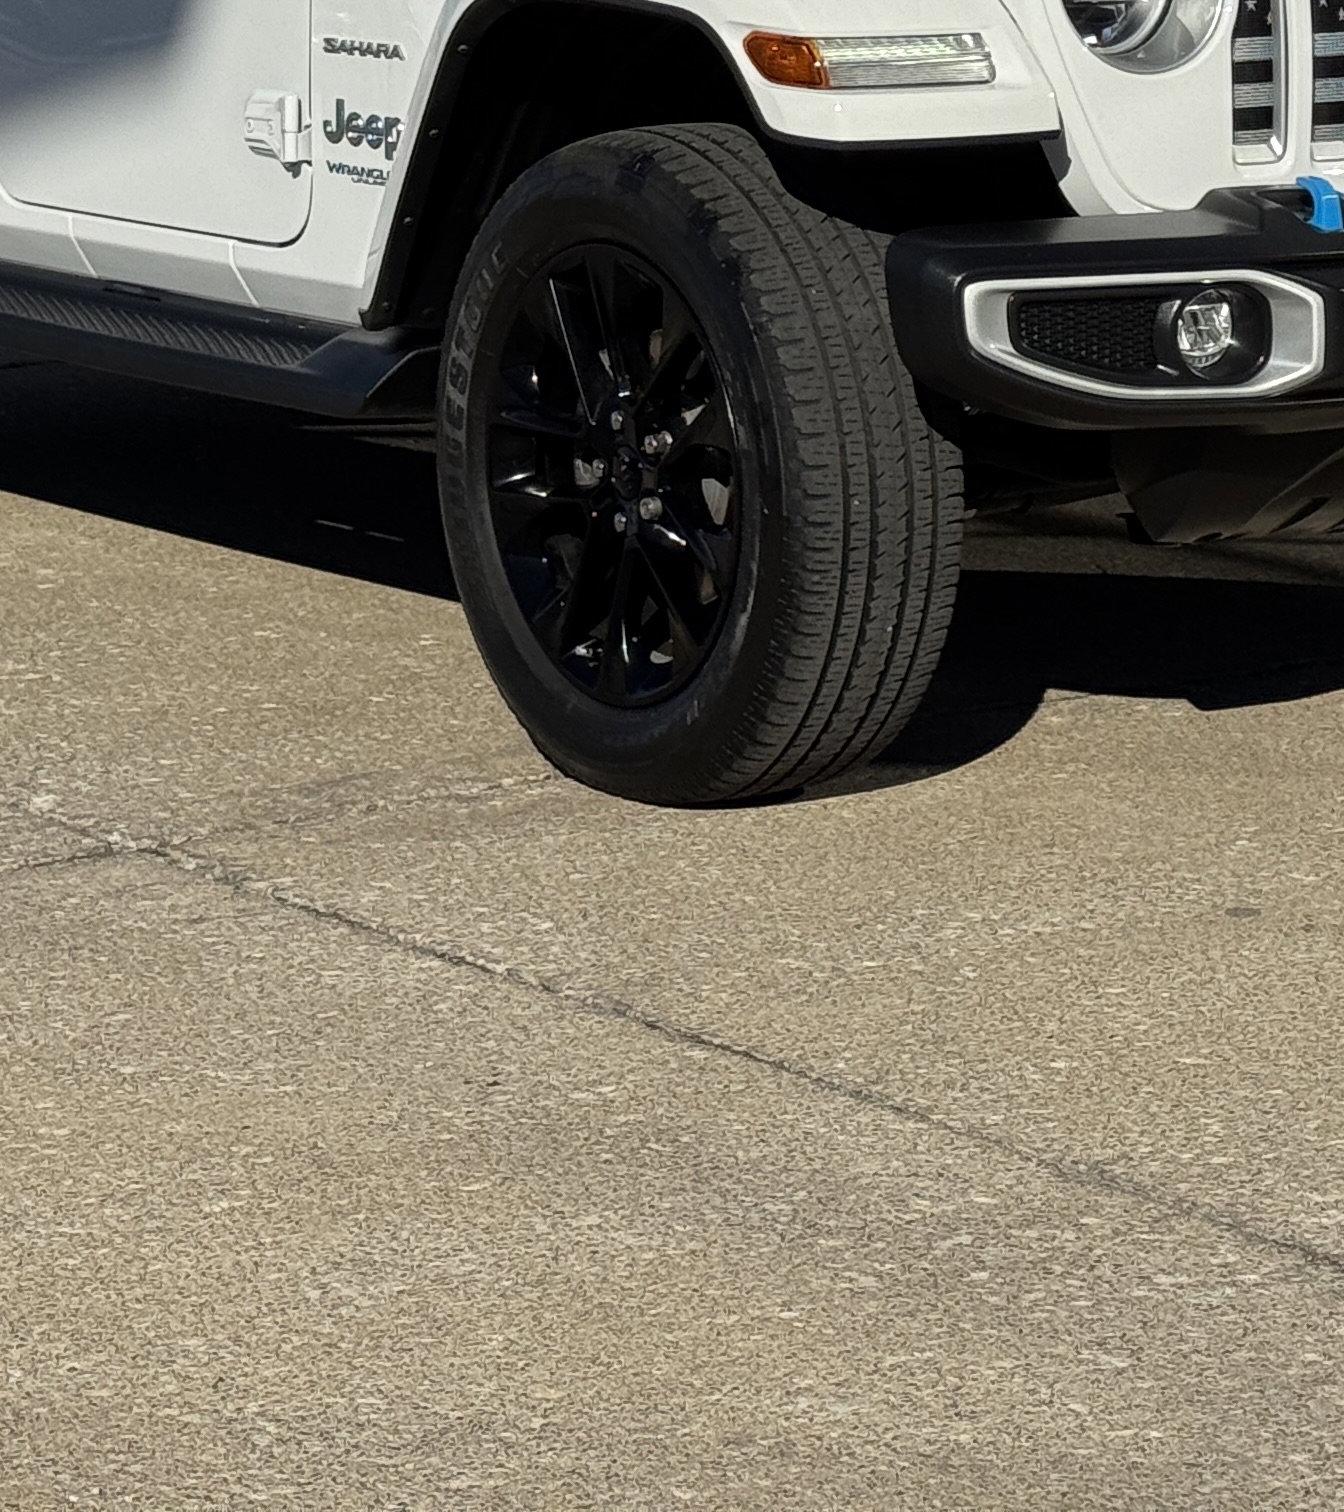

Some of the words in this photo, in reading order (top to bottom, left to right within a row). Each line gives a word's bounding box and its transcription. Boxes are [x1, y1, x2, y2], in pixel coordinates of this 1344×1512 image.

[323, 37, 405, 60] SAHARA
[323, 98, 404, 160] Jeep
[326, 160, 390, 180] WRANGL
